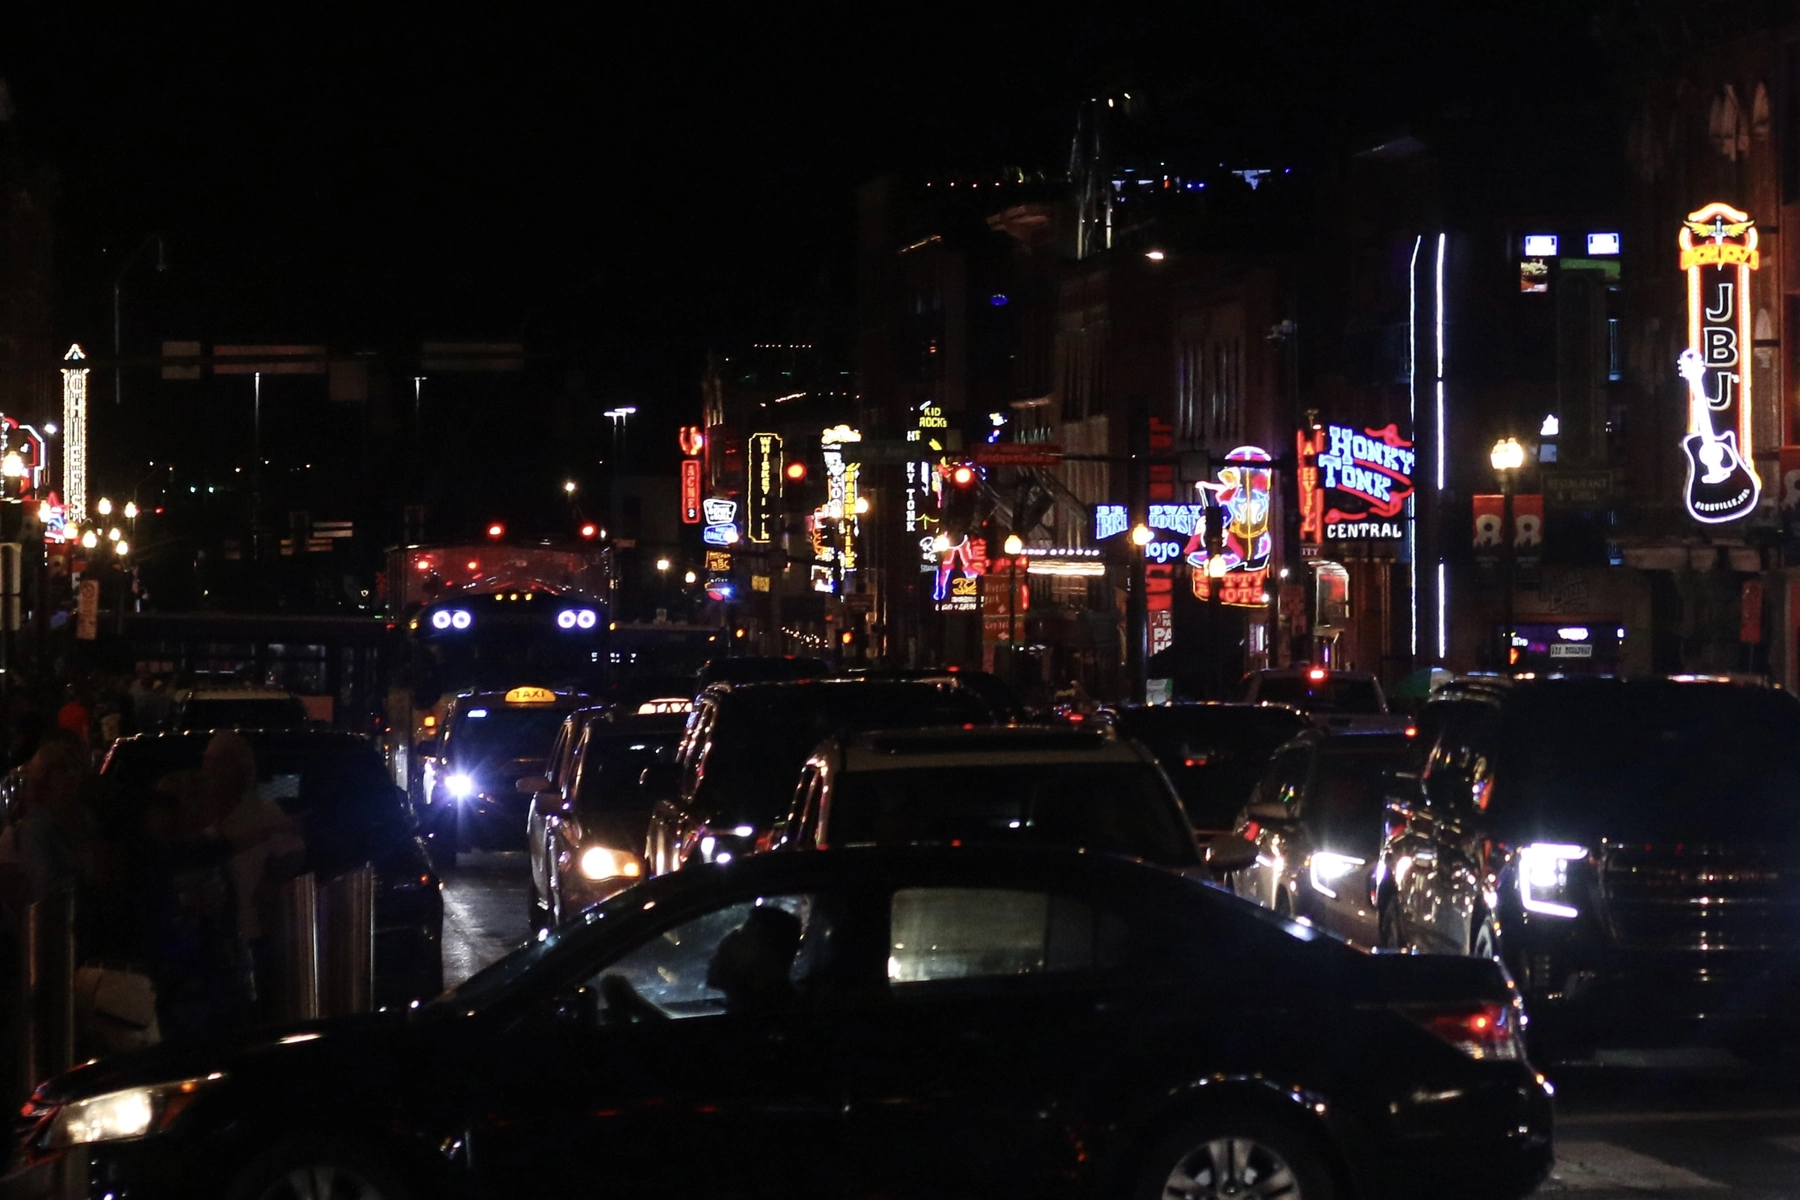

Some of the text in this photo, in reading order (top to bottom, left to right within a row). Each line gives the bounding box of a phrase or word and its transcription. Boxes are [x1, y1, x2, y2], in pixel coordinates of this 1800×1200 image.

[924, 407, 941, 416] KID
[69, 374, 83, 514] CHIEFS
[1329, 426, 1412, 475] HONKY
[1318, 454, 1391, 502] TONK
[906, 489, 917, 531] TONK
[1327, 523, 1402, 538] CENTRAL
